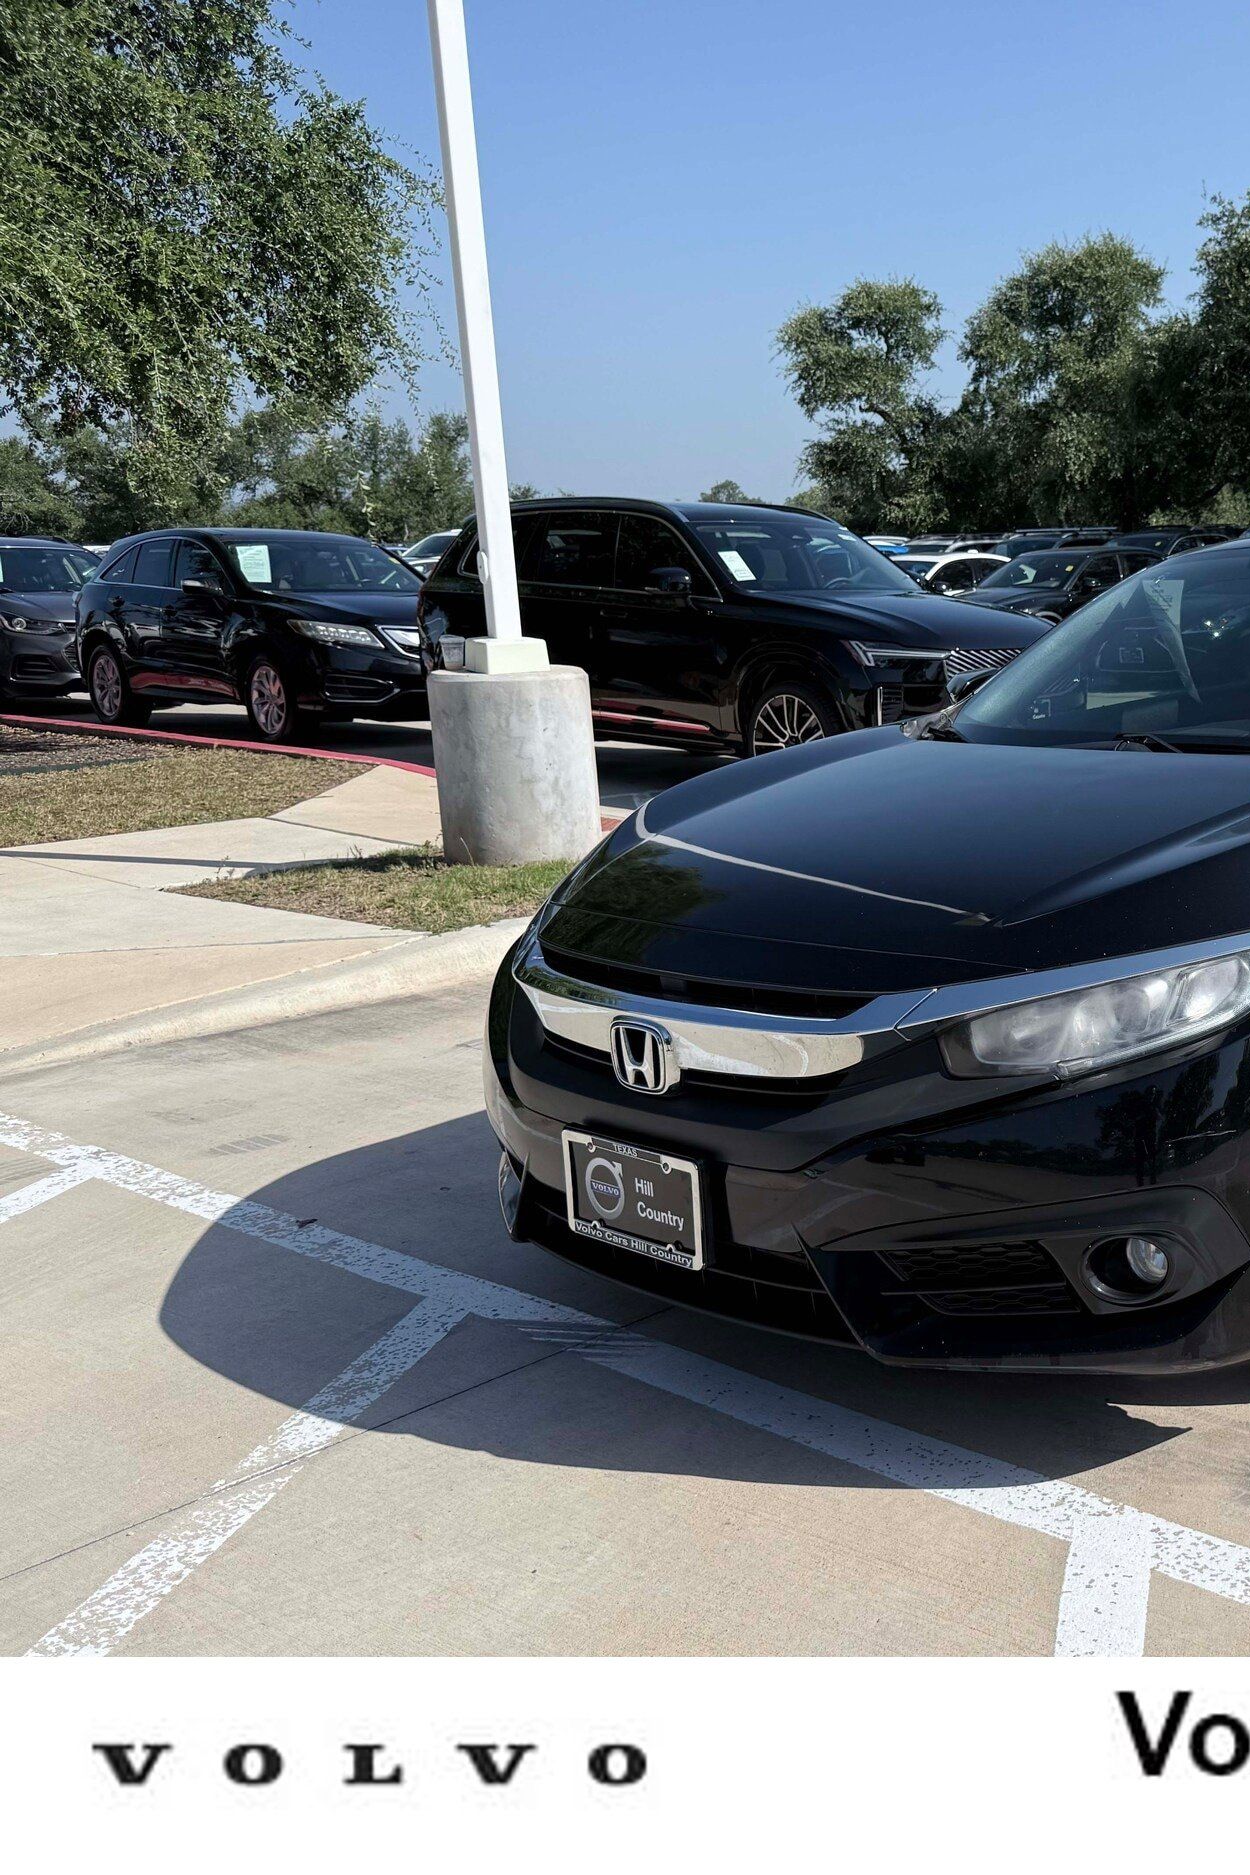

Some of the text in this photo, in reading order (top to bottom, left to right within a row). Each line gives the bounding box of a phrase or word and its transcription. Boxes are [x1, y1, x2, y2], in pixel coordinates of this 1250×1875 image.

[613, 1144, 638, 1157] TEXAS
[591, 1181, 619, 1196] VOLVO
[635, 1178, 654, 1197] Hill
[637, 1201, 685, 1231] Country
[575, 1222, 693, 1267] Volvo Cars Hill Country
